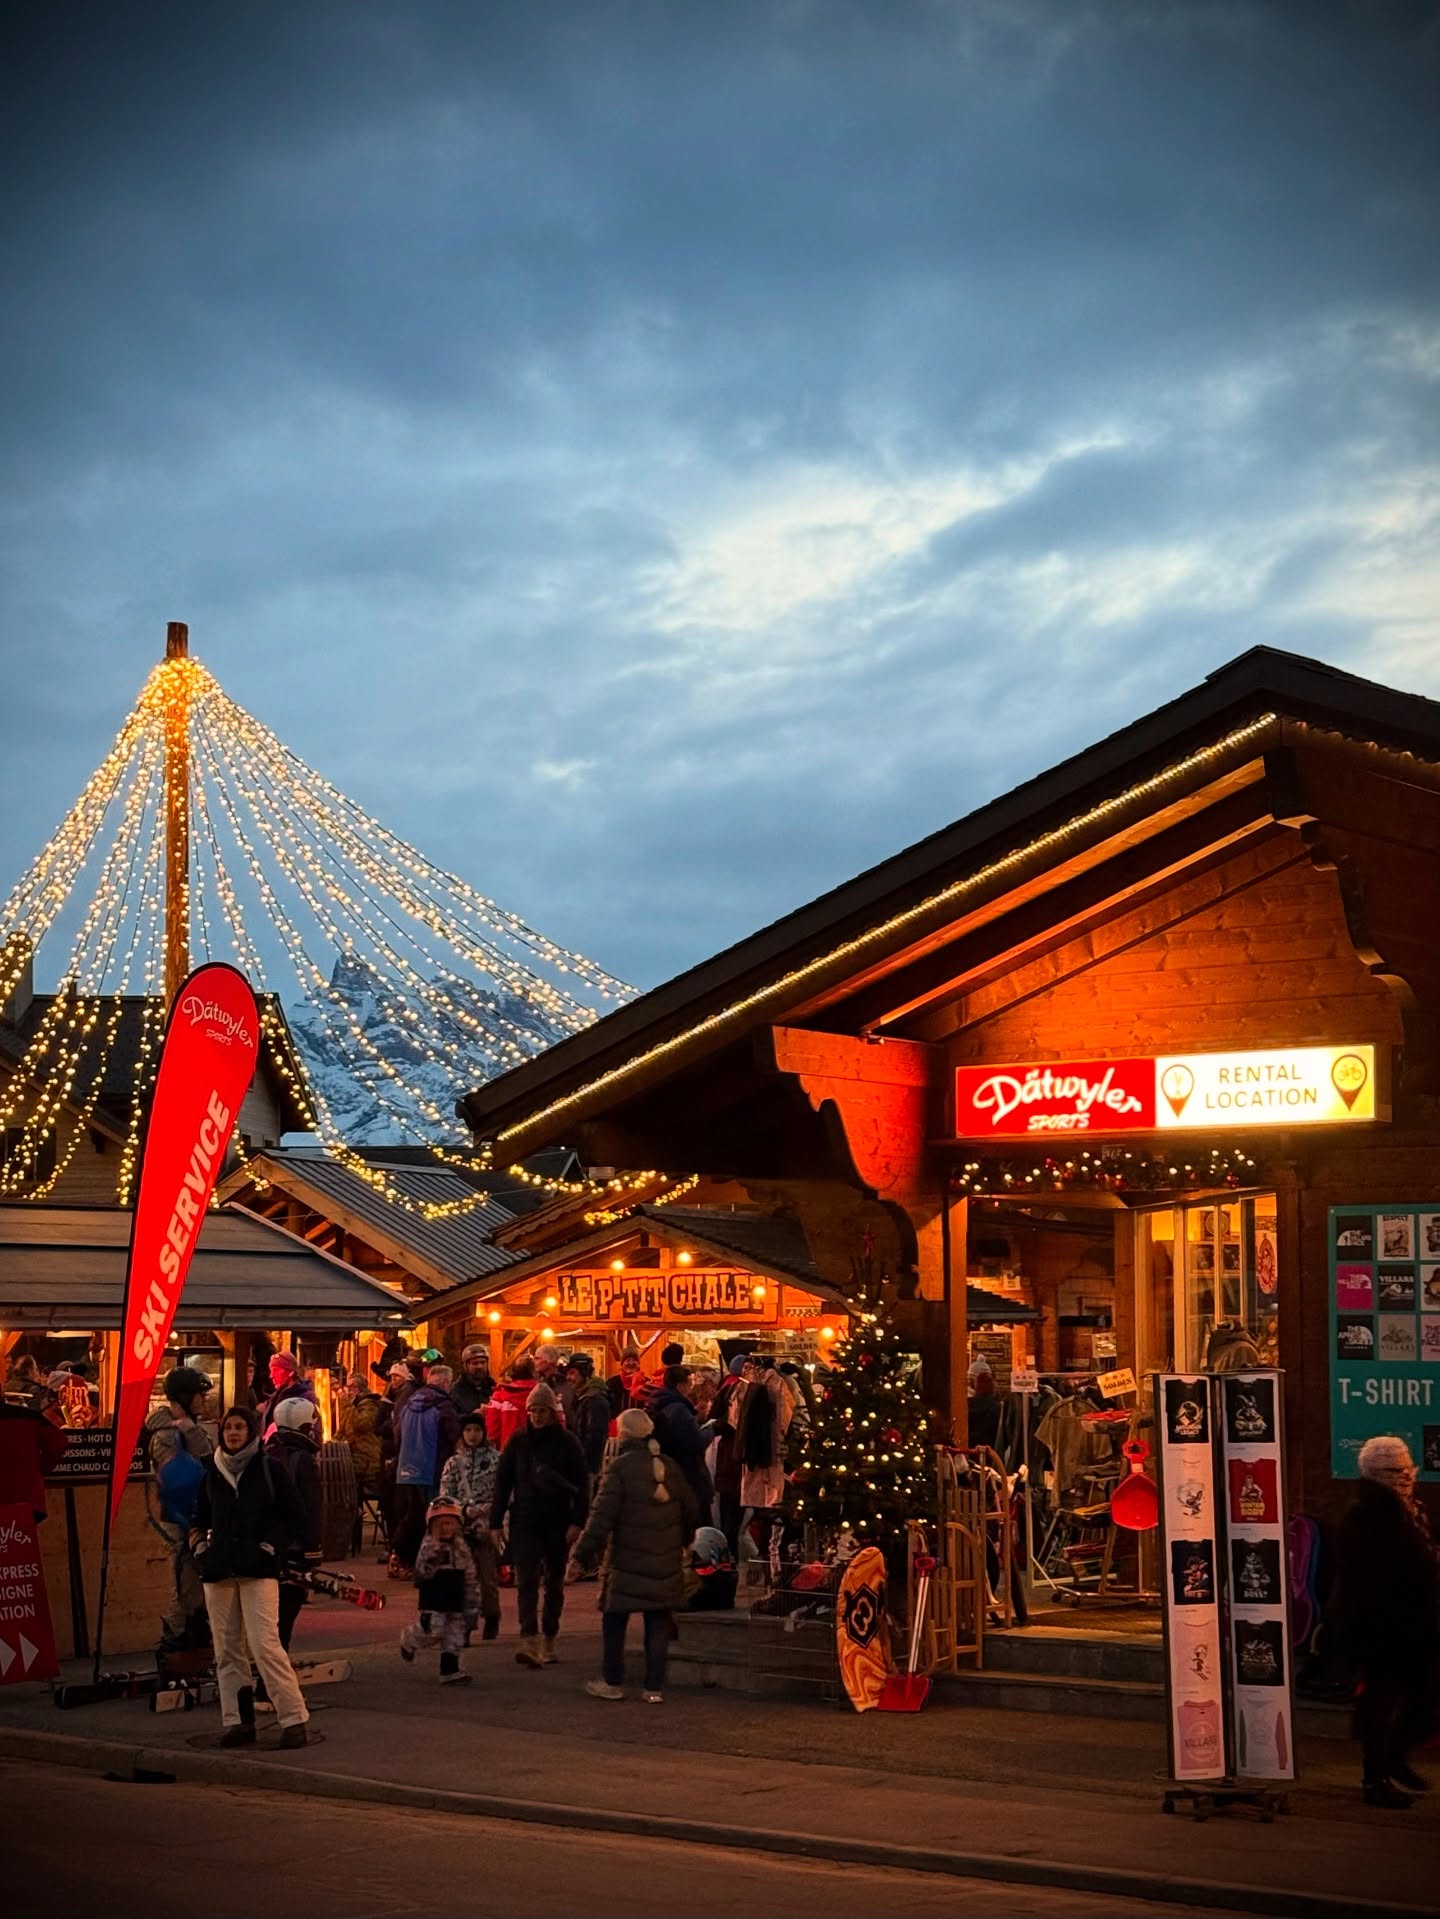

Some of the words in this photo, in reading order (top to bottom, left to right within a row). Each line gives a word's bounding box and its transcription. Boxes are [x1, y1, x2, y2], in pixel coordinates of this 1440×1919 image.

[182, 996, 253, 1048] Dätwyler
[205, 1029, 232, 1046] SPORTS
[1218, 1063, 1303, 1084] RENTAL
[973, 1067, 1142, 1125] Dätwyler
[1204, 1087, 1319, 1110] LOCATION
[1027, 1113, 1091, 1130] SPORTS
[133, 1279, 170, 1369] SKI
[158, 1088, 230, 1284] SERVICE
[559, 1276, 592, 1315] LE
[595, 1276, 664, 1318] P'TIT
[669, 1274, 766, 1314] CHALET
[1103, 1378, 1132, 1391] SOLDES
[1337, 1378, 1435, 1406] T-SHIRT
[87, 1434, 104, 1443] HOT
[72, 1463, 101, 1472] CHAUD
